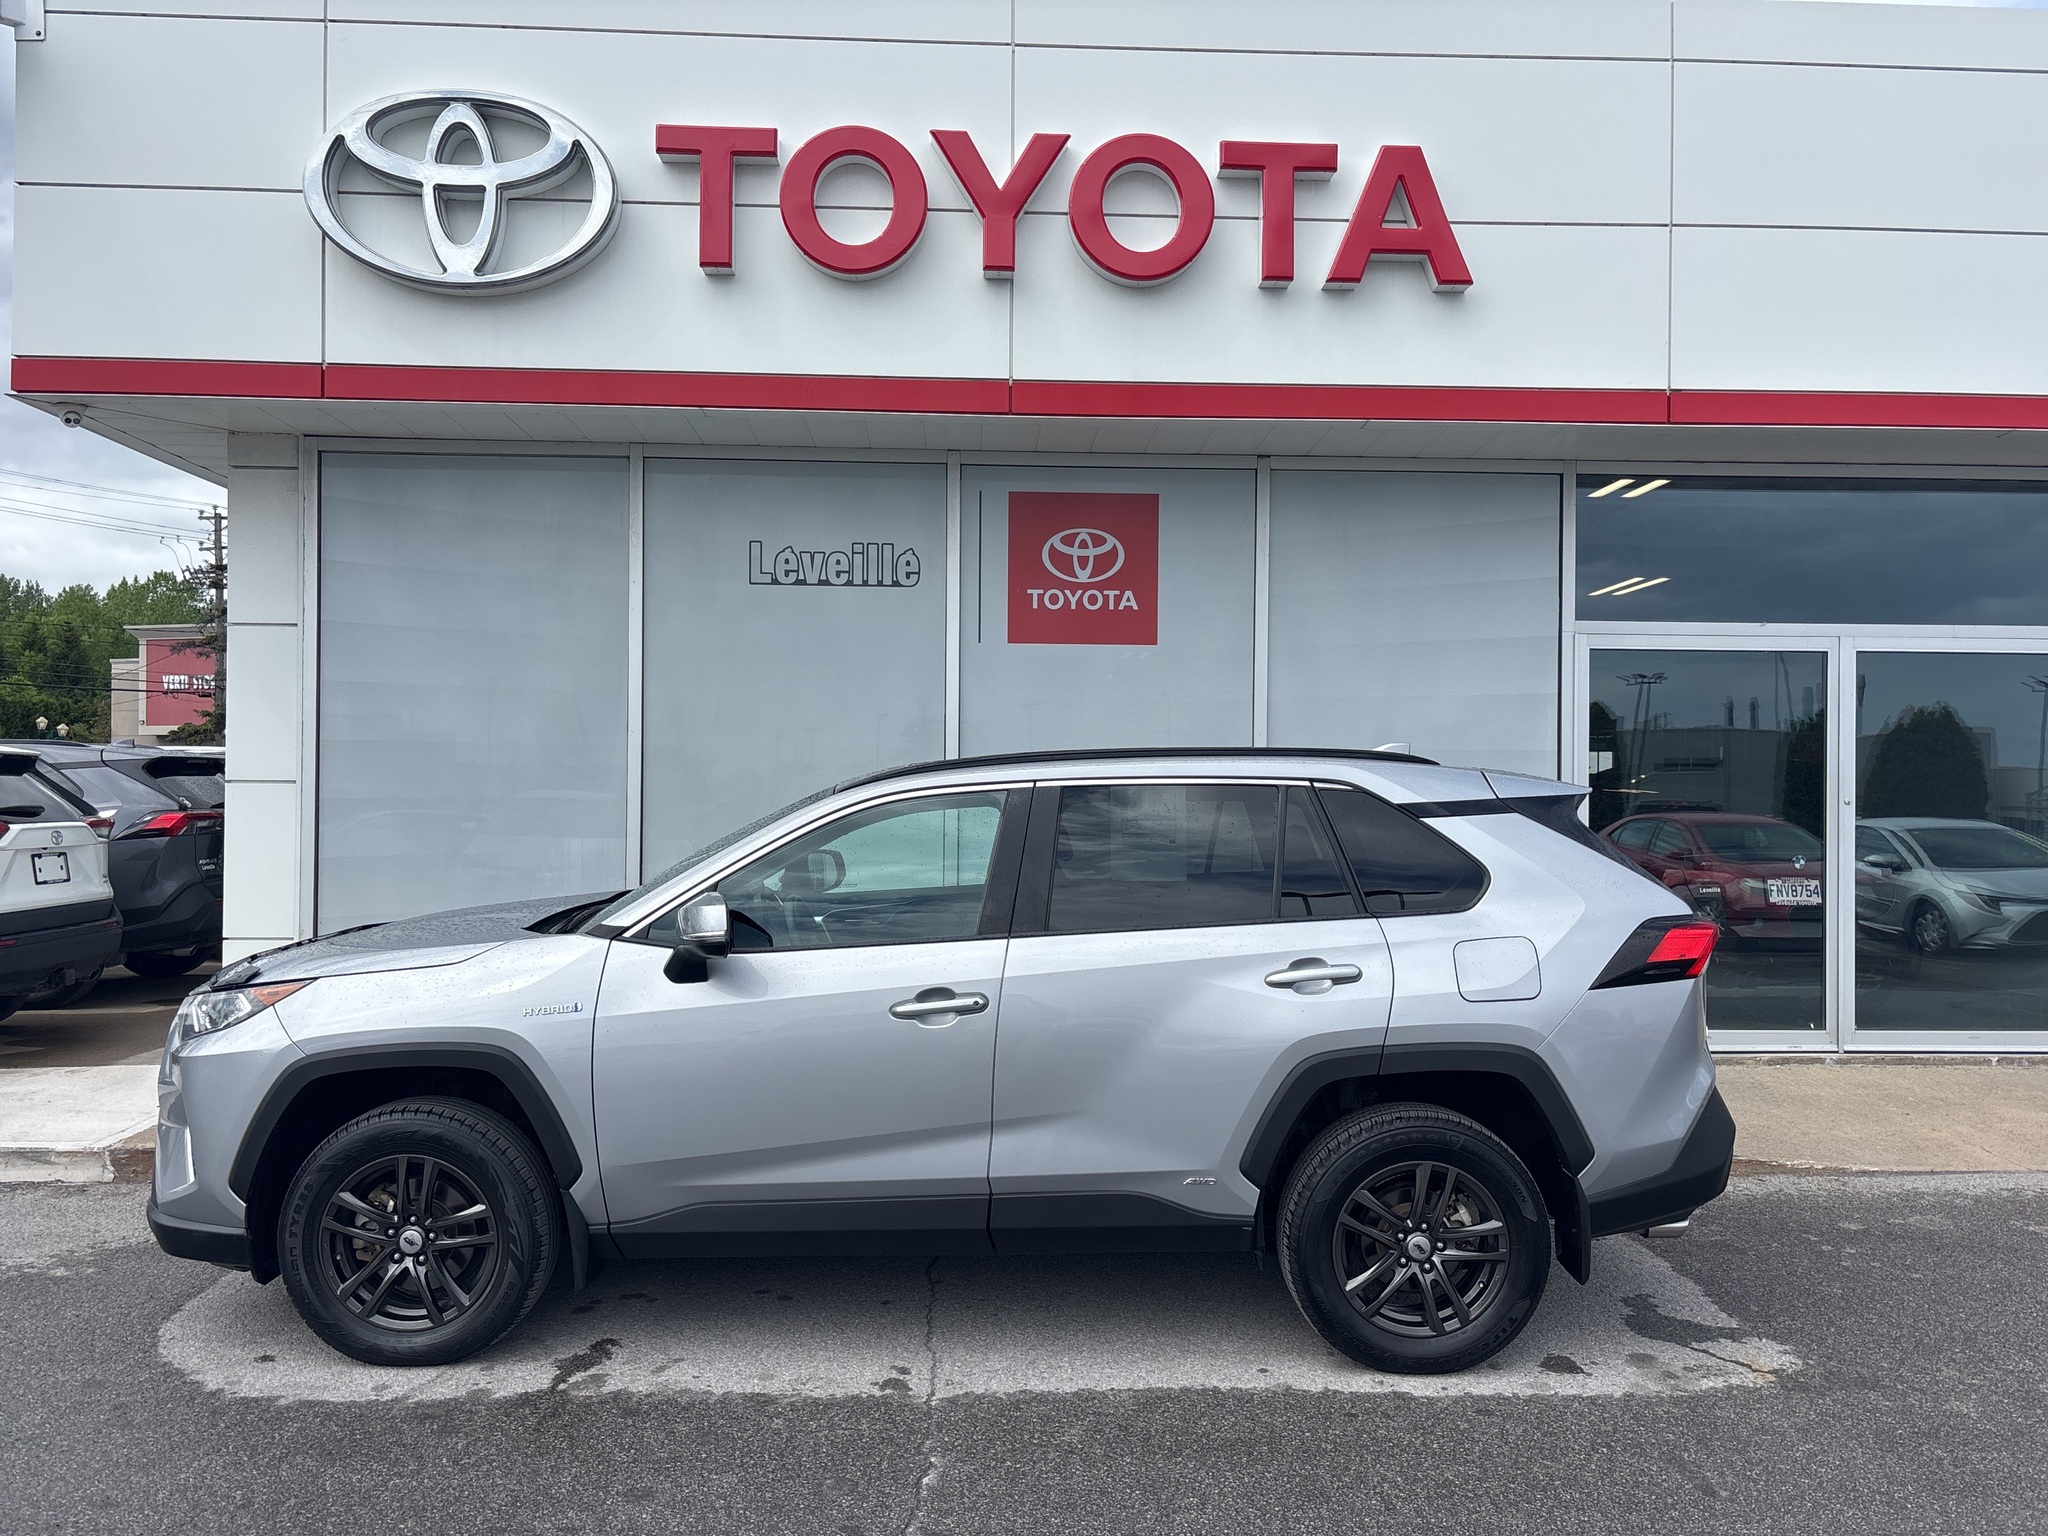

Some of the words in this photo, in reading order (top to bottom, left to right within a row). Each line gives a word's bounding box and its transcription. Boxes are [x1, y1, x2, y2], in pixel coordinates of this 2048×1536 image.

[655, 123, 1474, 293] TOYOTA
[749, 540, 921, 588] Léveillé
[1027, 589, 1139, 611] TOYOTA
[162, 675, 189, 690] VERTI
[1768, 883, 1820, 898] FNV8754
[523, 1005, 573, 1017] HYBRID
[1183, 1177, 1217, 1185] AWD
[290, 1181, 315, 1238] TYRES
